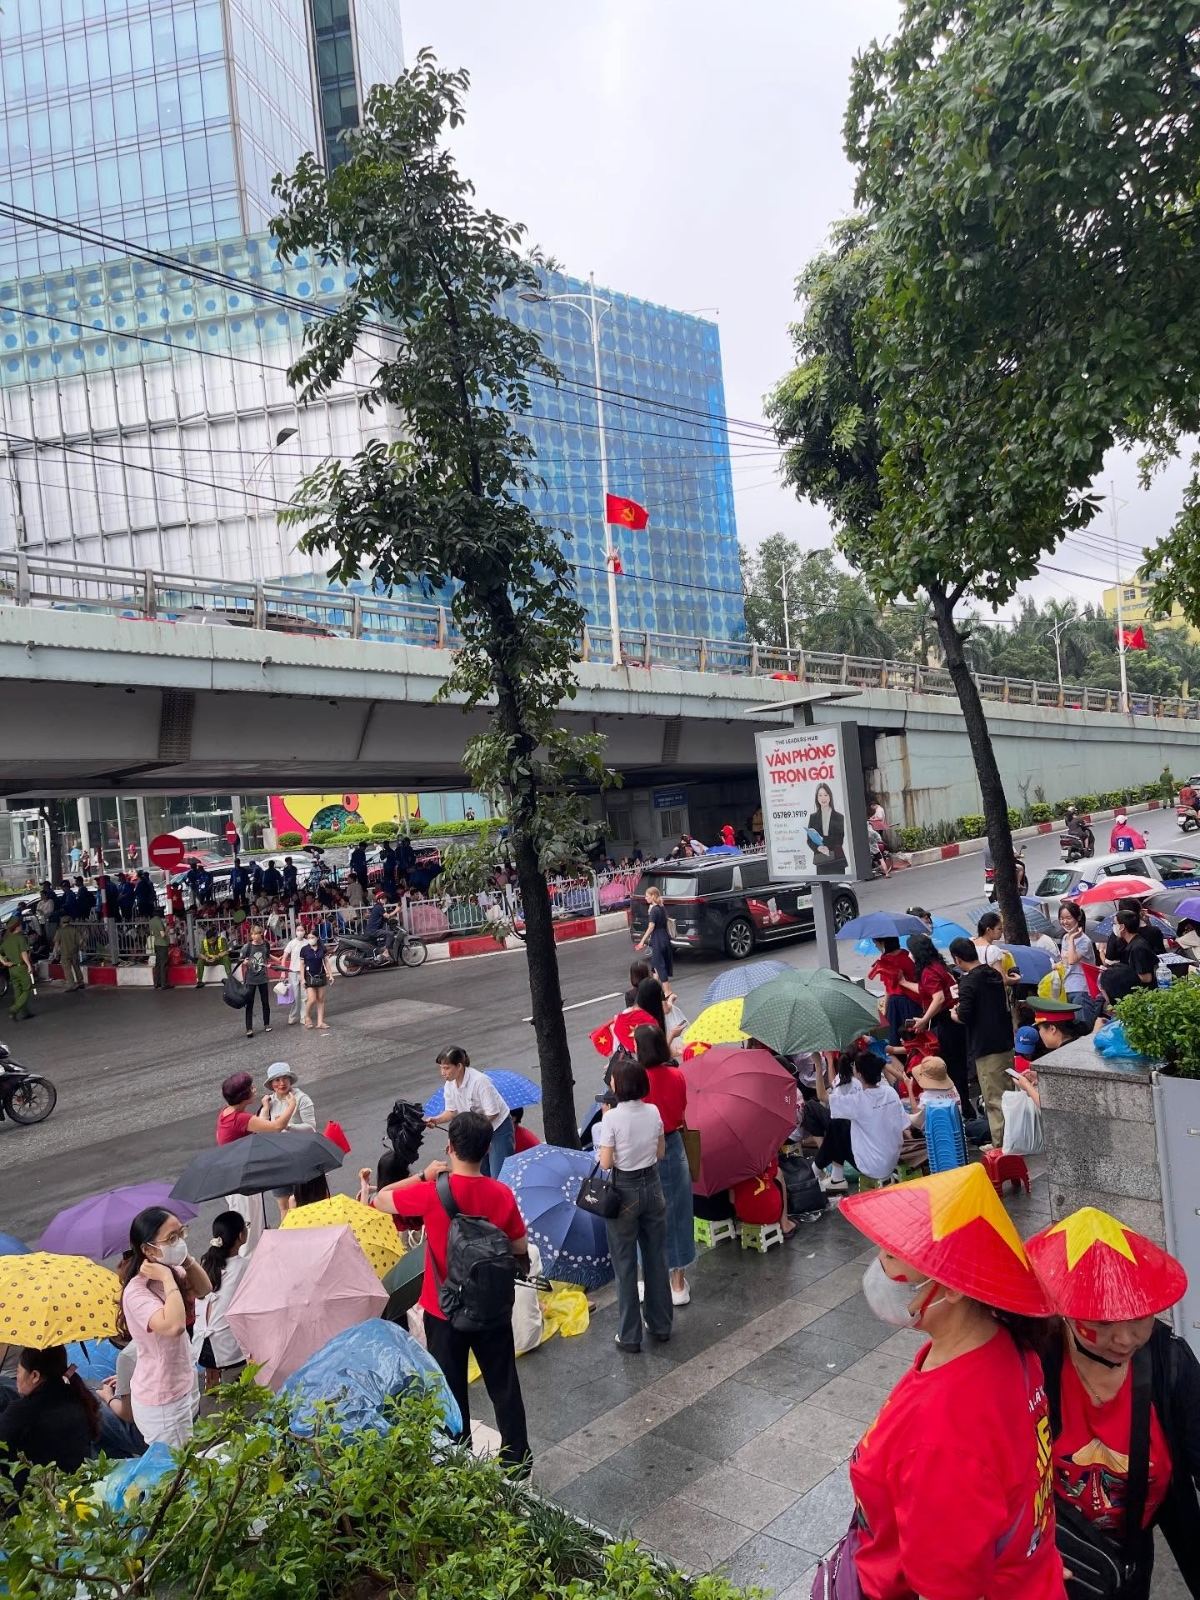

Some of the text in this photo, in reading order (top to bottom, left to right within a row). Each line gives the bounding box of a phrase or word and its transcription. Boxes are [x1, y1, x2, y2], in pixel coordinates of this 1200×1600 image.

[765, 743, 836, 767] VĂN PHÒNG
[769, 761, 835, 787] TRỌN GÓI
